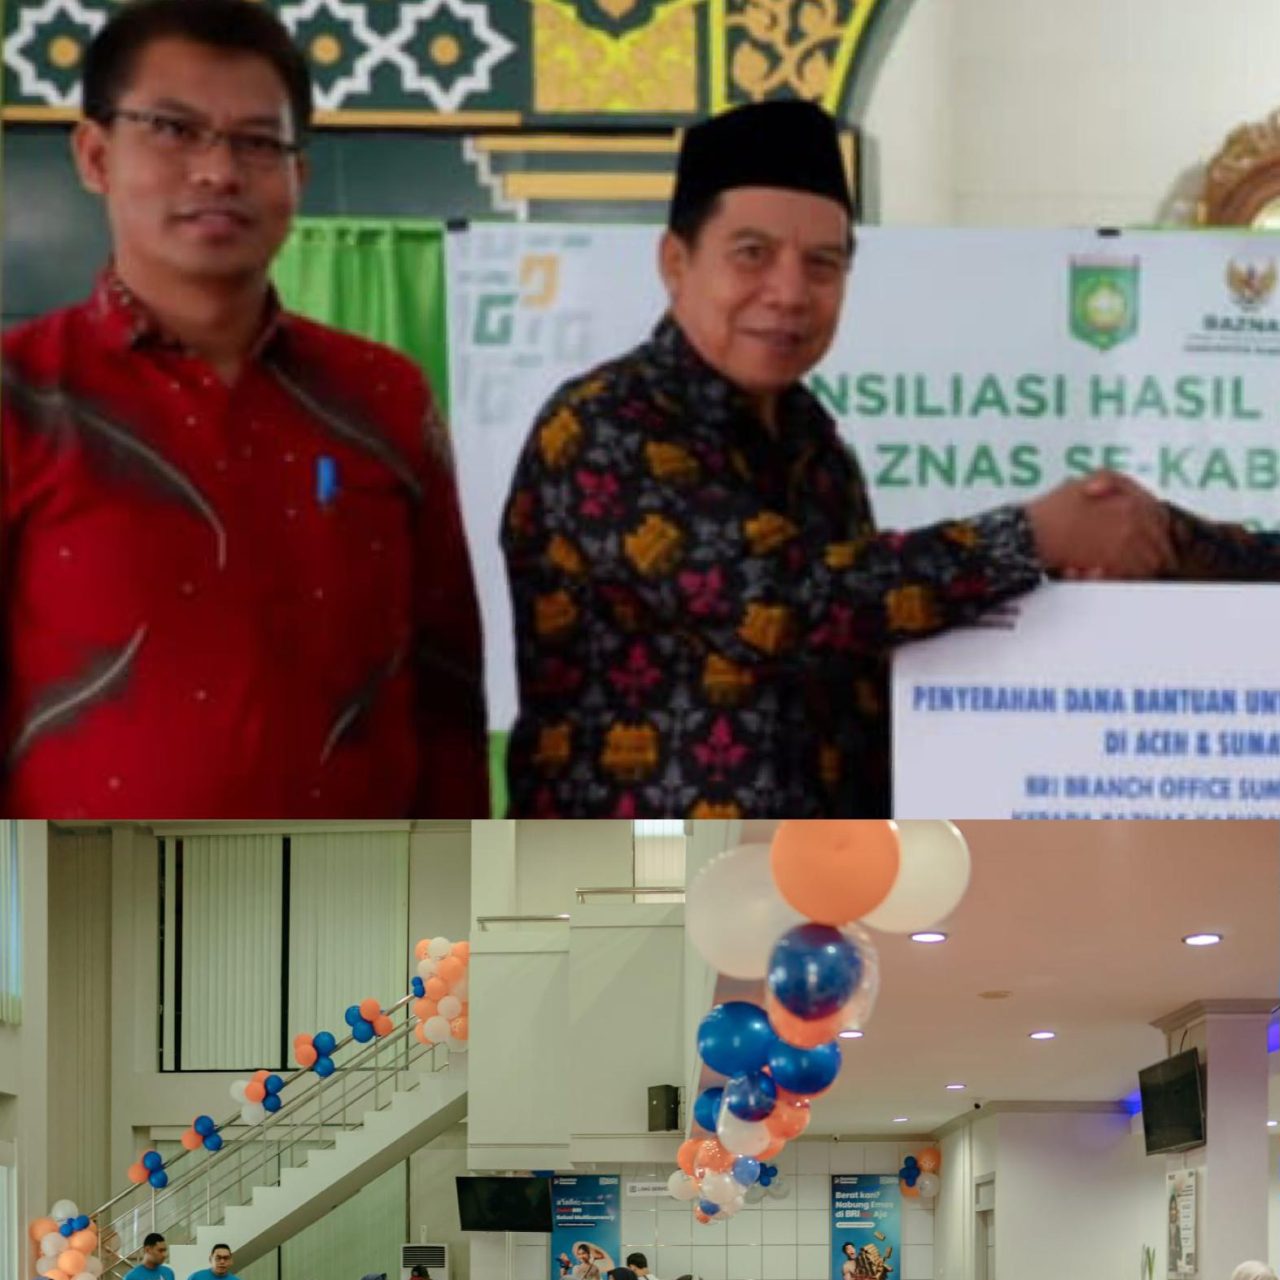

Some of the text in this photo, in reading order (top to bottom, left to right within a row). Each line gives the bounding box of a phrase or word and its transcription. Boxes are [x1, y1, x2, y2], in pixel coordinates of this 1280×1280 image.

[808, 373, 1066, 419] NSILIASI
[1090, 375, 1261, 420] HASIL
[866, 443, 1042, 489] ZNAS
[913, 686, 1056, 712] PENYERAHAN
[1064, 688, 1127, 713] DANA
[1133, 688, 1237, 714] BANTUAN
[1104, 730, 1127, 755] DI
[1135, 731, 1189, 756] ACEH
[1064, 775, 1155, 798] BRANCH
[1159, 776, 1231, 800] OFFICE
[835, 1191, 859, 1199] Berat
[835, 1201, 870, 1210] Nabung
